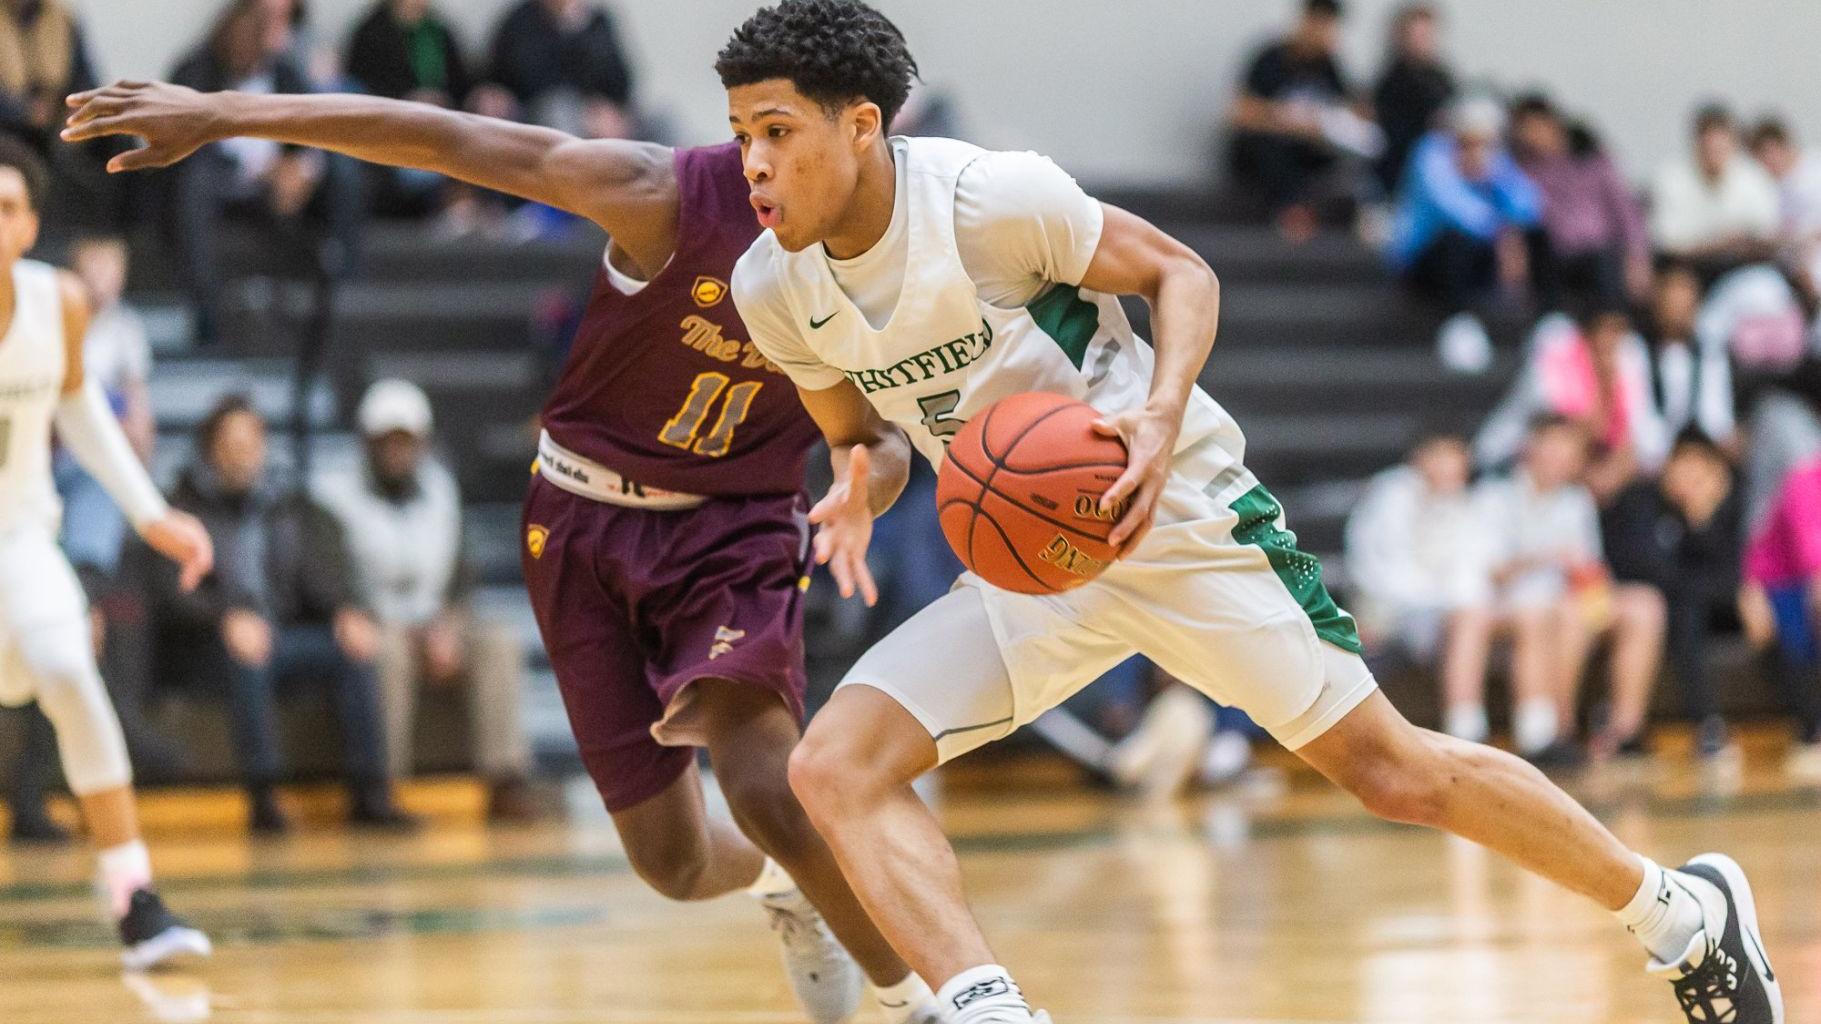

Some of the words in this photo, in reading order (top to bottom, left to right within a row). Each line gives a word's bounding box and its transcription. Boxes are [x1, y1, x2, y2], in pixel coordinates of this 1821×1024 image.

[680, 314, 740, 362] The
[657, 371, 764, 458] 11
[917, 388, 969, 444] 5
